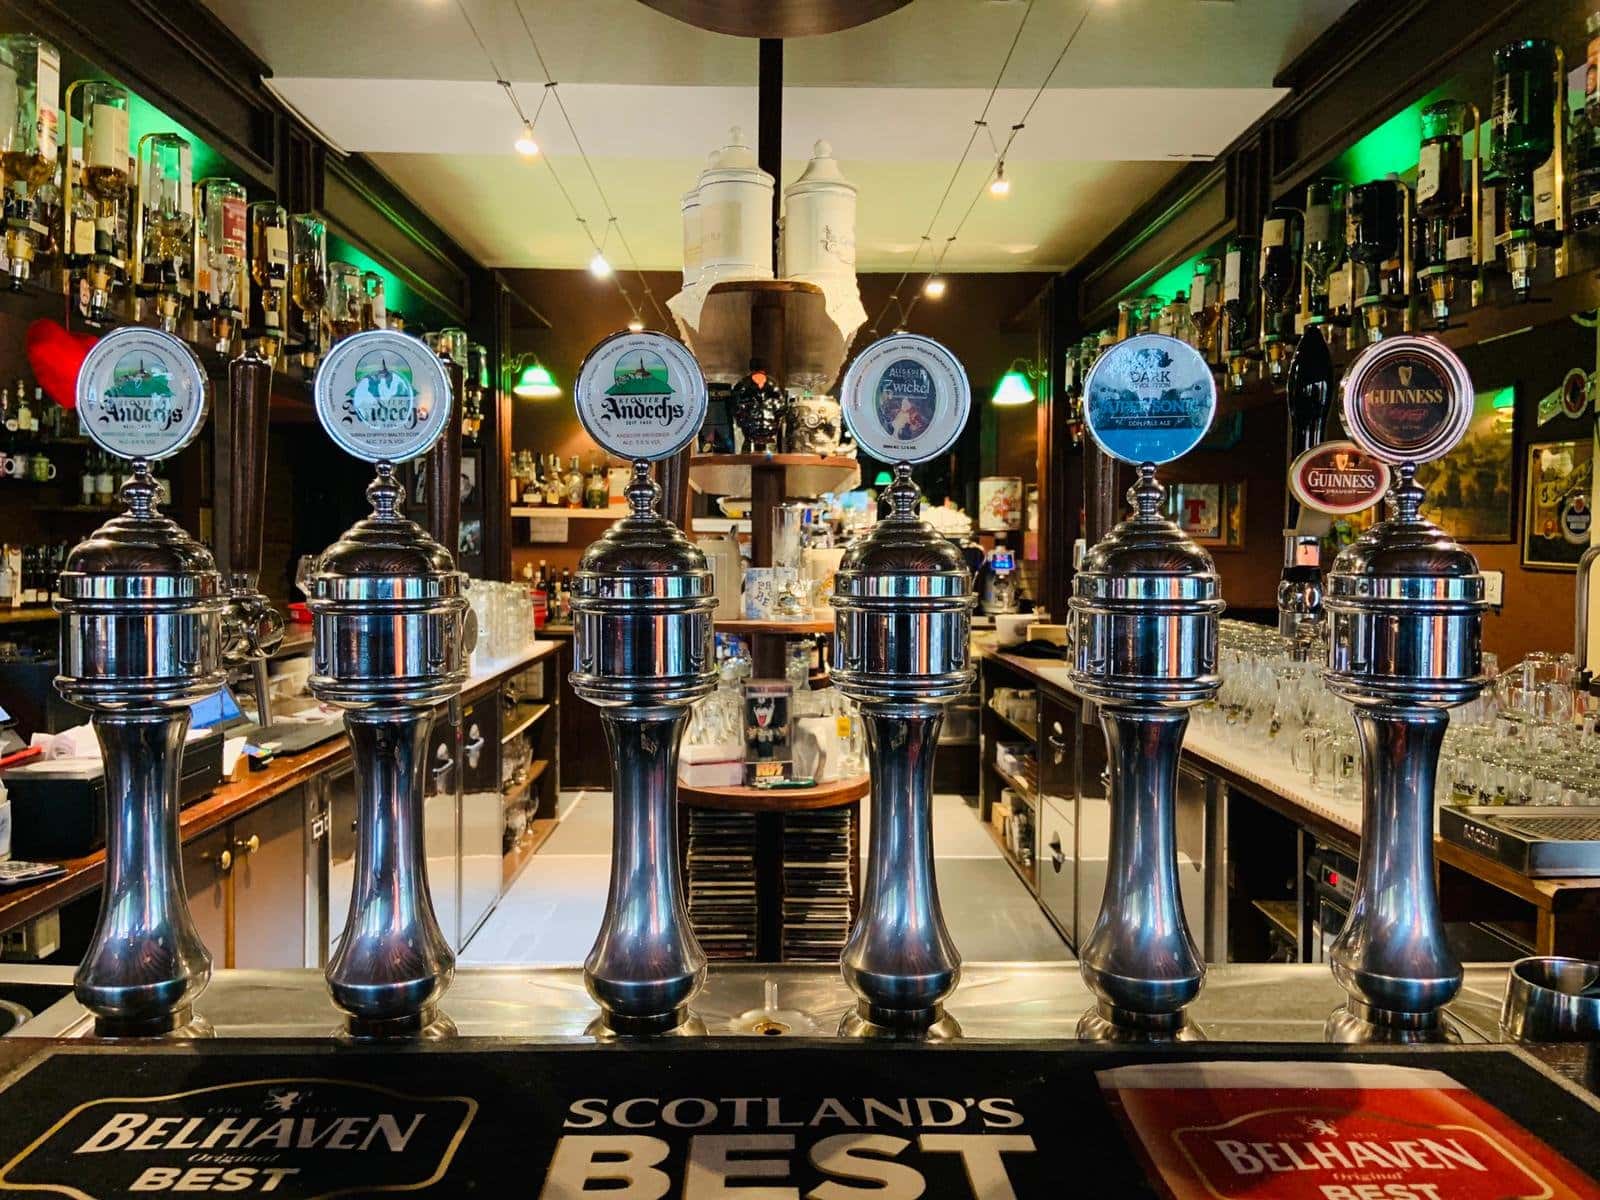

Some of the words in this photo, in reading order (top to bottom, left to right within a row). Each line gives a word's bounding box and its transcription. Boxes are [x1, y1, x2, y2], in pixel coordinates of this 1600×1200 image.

[601, 396, 684, 427] Andechs
[1369, 389, 1443, 404] GUINNESS
[1308, 470, 1375, 489] GUINNESS
[563, 1097, 1025, 1128] SCOTLAND'S
[73, 1112, 426, 1154] BELHAVEN
[539, 1134, 1038, 1200] BEST
[1214, 1137, 1489, 1176] BELHAVEN
[128, 1166, 302, 1192] BEST
[1318, 1183, 1440, 1200] BEST
